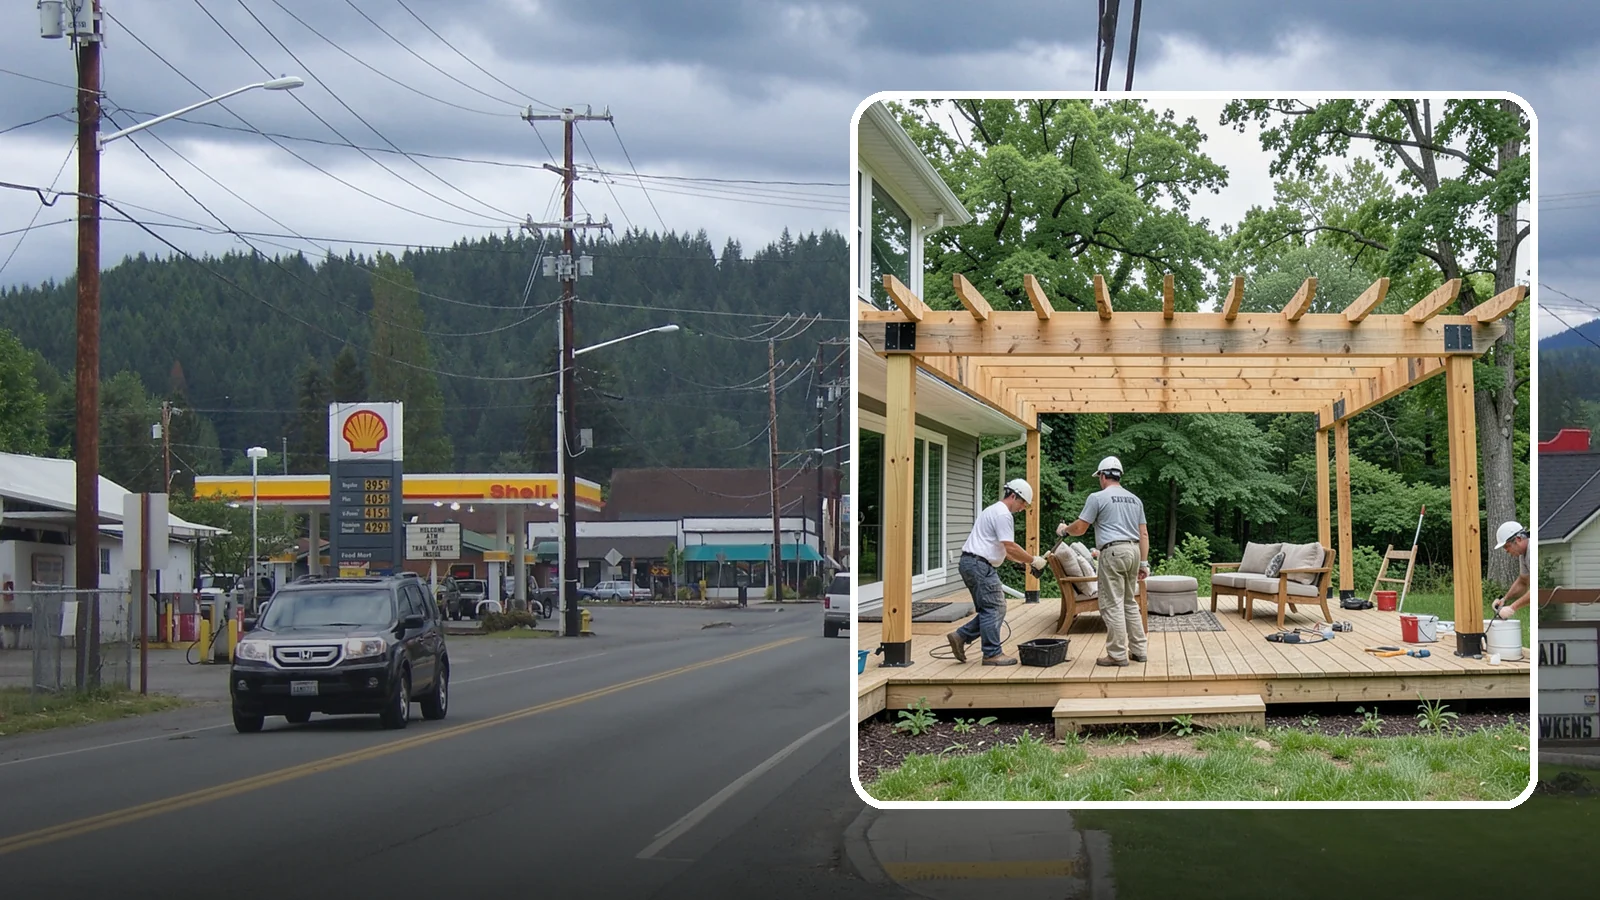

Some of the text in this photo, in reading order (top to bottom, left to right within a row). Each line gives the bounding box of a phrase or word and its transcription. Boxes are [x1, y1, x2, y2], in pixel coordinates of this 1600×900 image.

[365, 480, 383, 490] 395
[490, 484, 547, 499] Shell
[365, 494, 383, 504] 405
[365, 508, 383, 518] 415
[365, 522, 383, 532] 429
[1538, 643, 1567, 666] AID
[1538, 716, 1592, 739] WKENS
